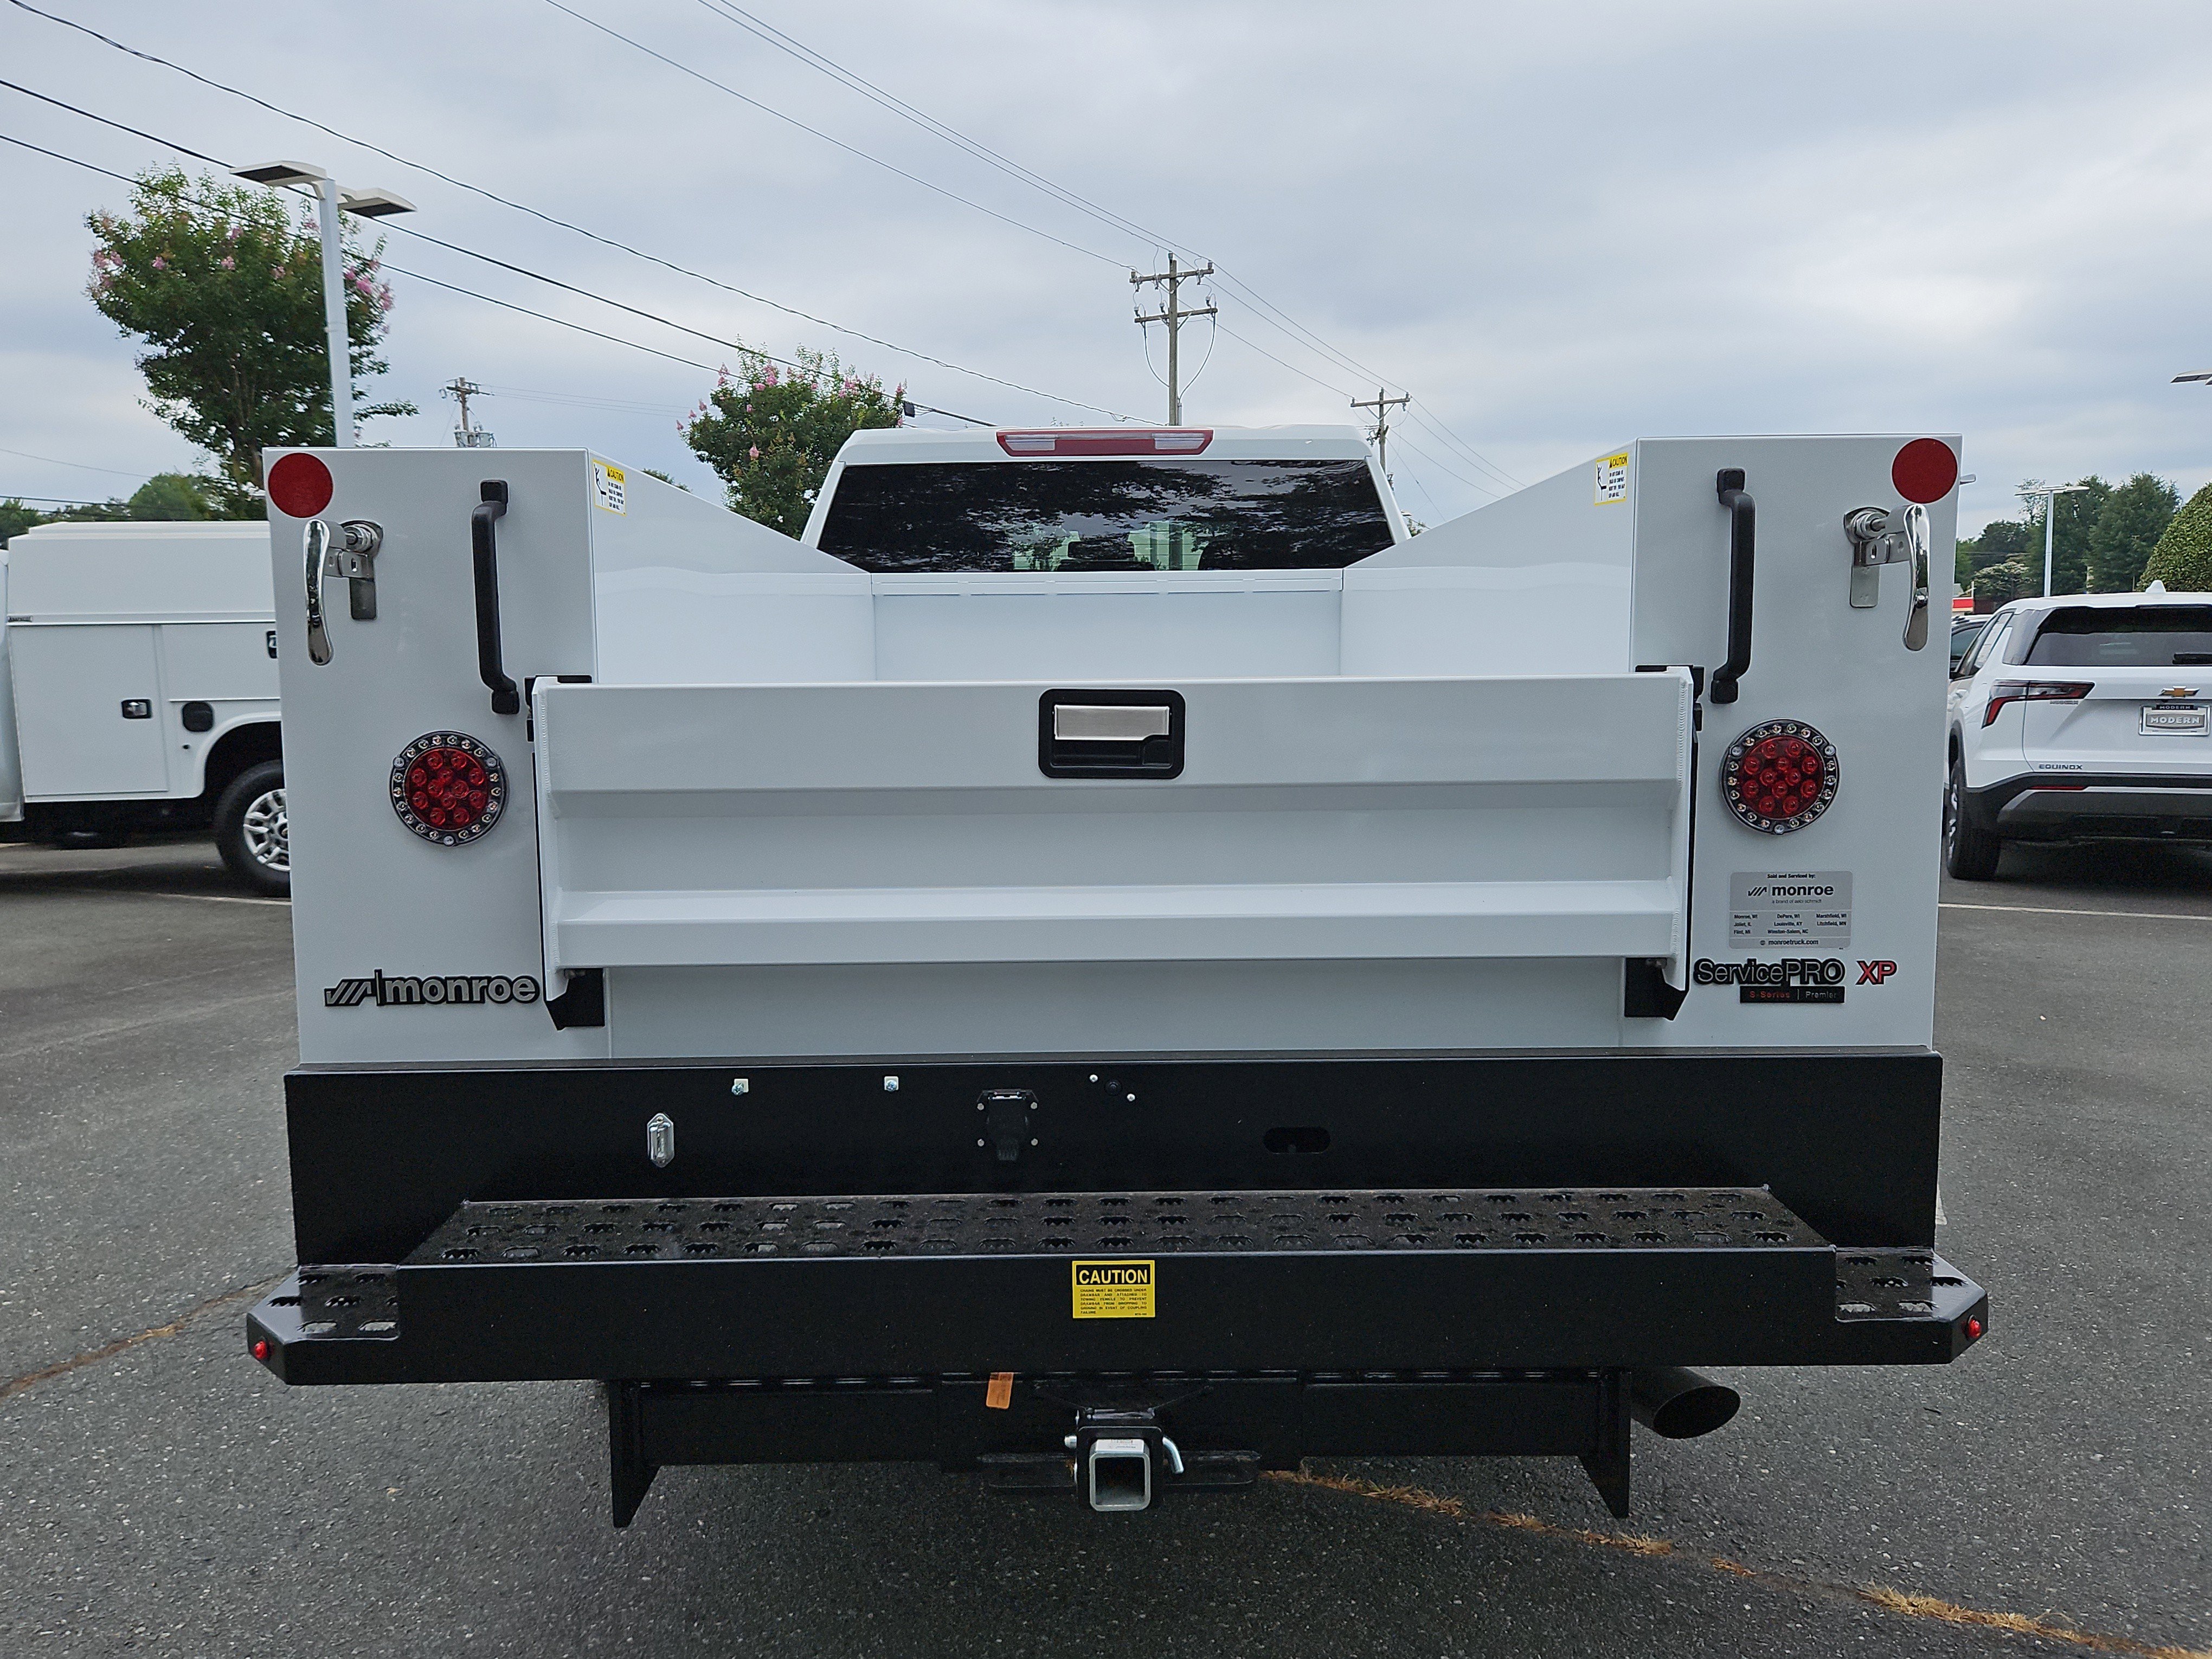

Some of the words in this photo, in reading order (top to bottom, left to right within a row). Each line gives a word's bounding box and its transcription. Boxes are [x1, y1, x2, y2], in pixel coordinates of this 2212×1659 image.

[1772, 885, 1834, 896] monroe
[1693, 958, 1845, 985] ServicePRO
[1856, 960, 1897, 985] XP
[382, 975, 540, 1005] monroe
[1805, 991, 1837, 999] Premier
[1078, 1269, 1148, 1284] CAUTION
